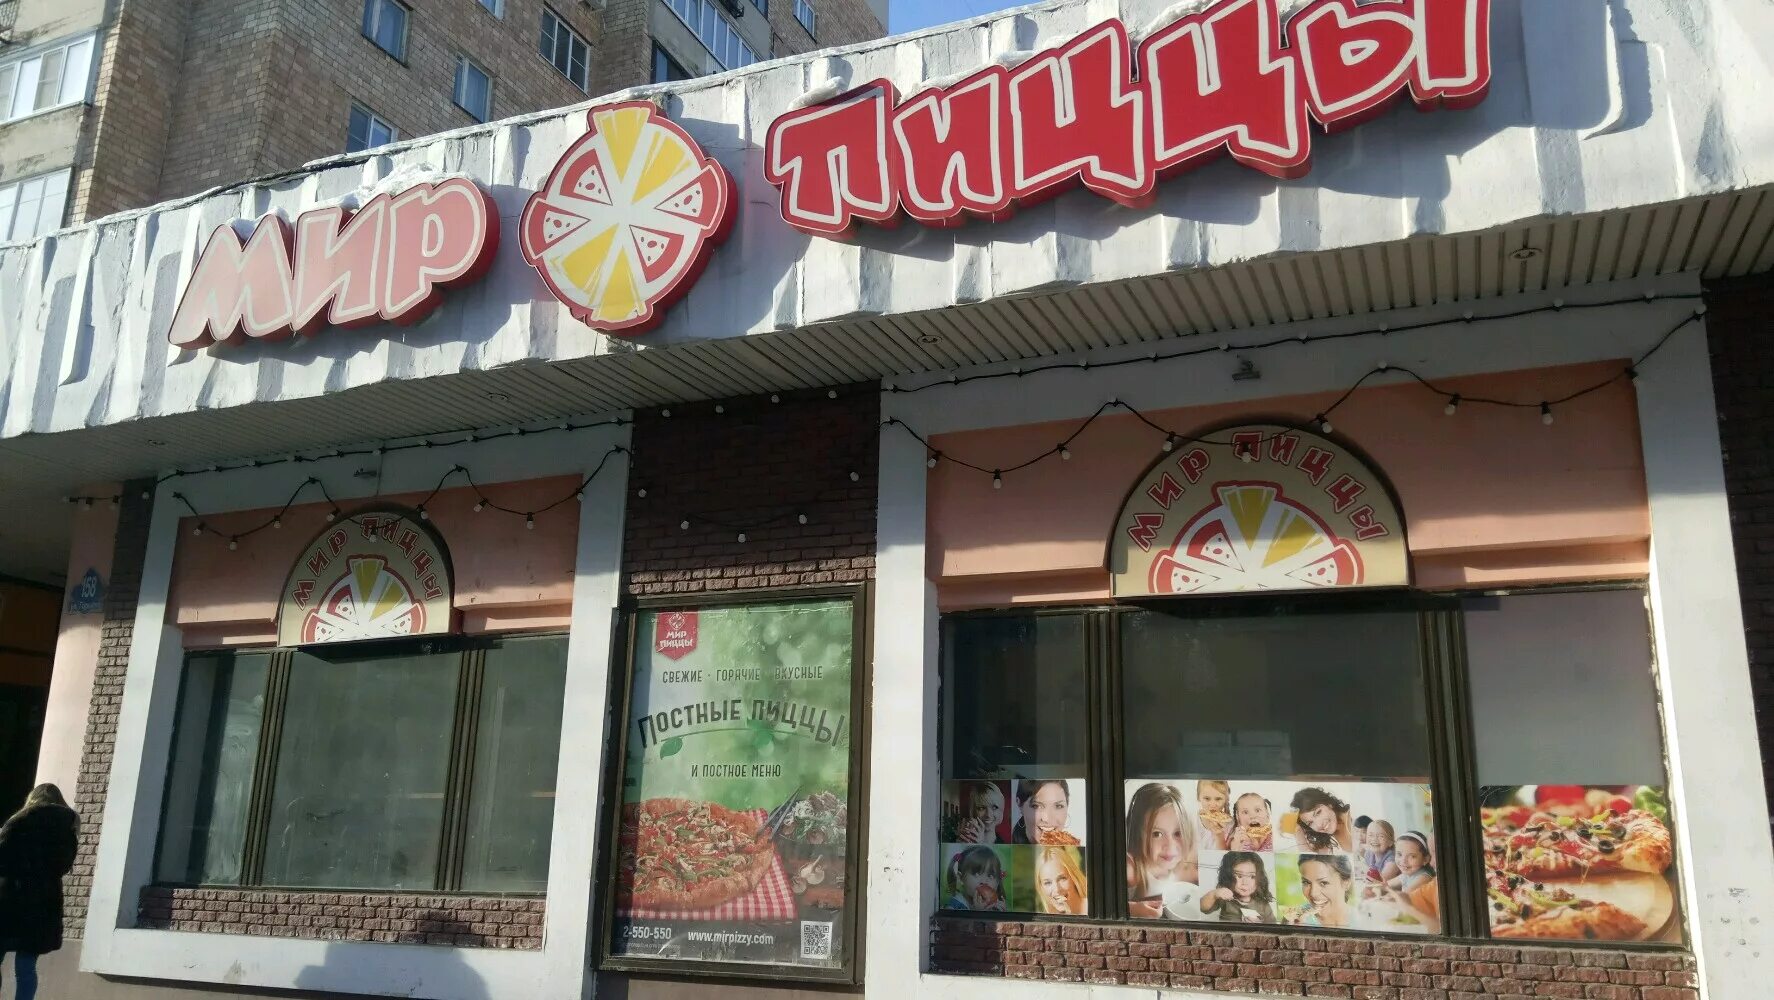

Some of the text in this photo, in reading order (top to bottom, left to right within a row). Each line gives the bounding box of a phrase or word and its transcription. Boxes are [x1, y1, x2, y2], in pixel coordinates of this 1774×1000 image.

[168, 0, 1491, 347] МИР ПИЦЦЫ
[1127, 431, 1390, 552] МИР ПИЦЦЫ
[292, 517, 443, 611] МИР ПИЦЦЫ
[659, 638, 693, 648] ПИЦЦЫ
[665, 630, 687, 640] МИР
[662, 666, 823, 684] СВЕЖИЕ ГОРЯЧИЕ ВКУСНЫЕ
[637, 699, 845, 749] ПОСТНЫЕ ПИЦЦЫ
[691, 764, 781, 778] И ПОСТНОЕ МЕНЮ
[622, 925, 672, 940] 2-550-550
[688, 931, 774, 945] www.mirpizzy.com
